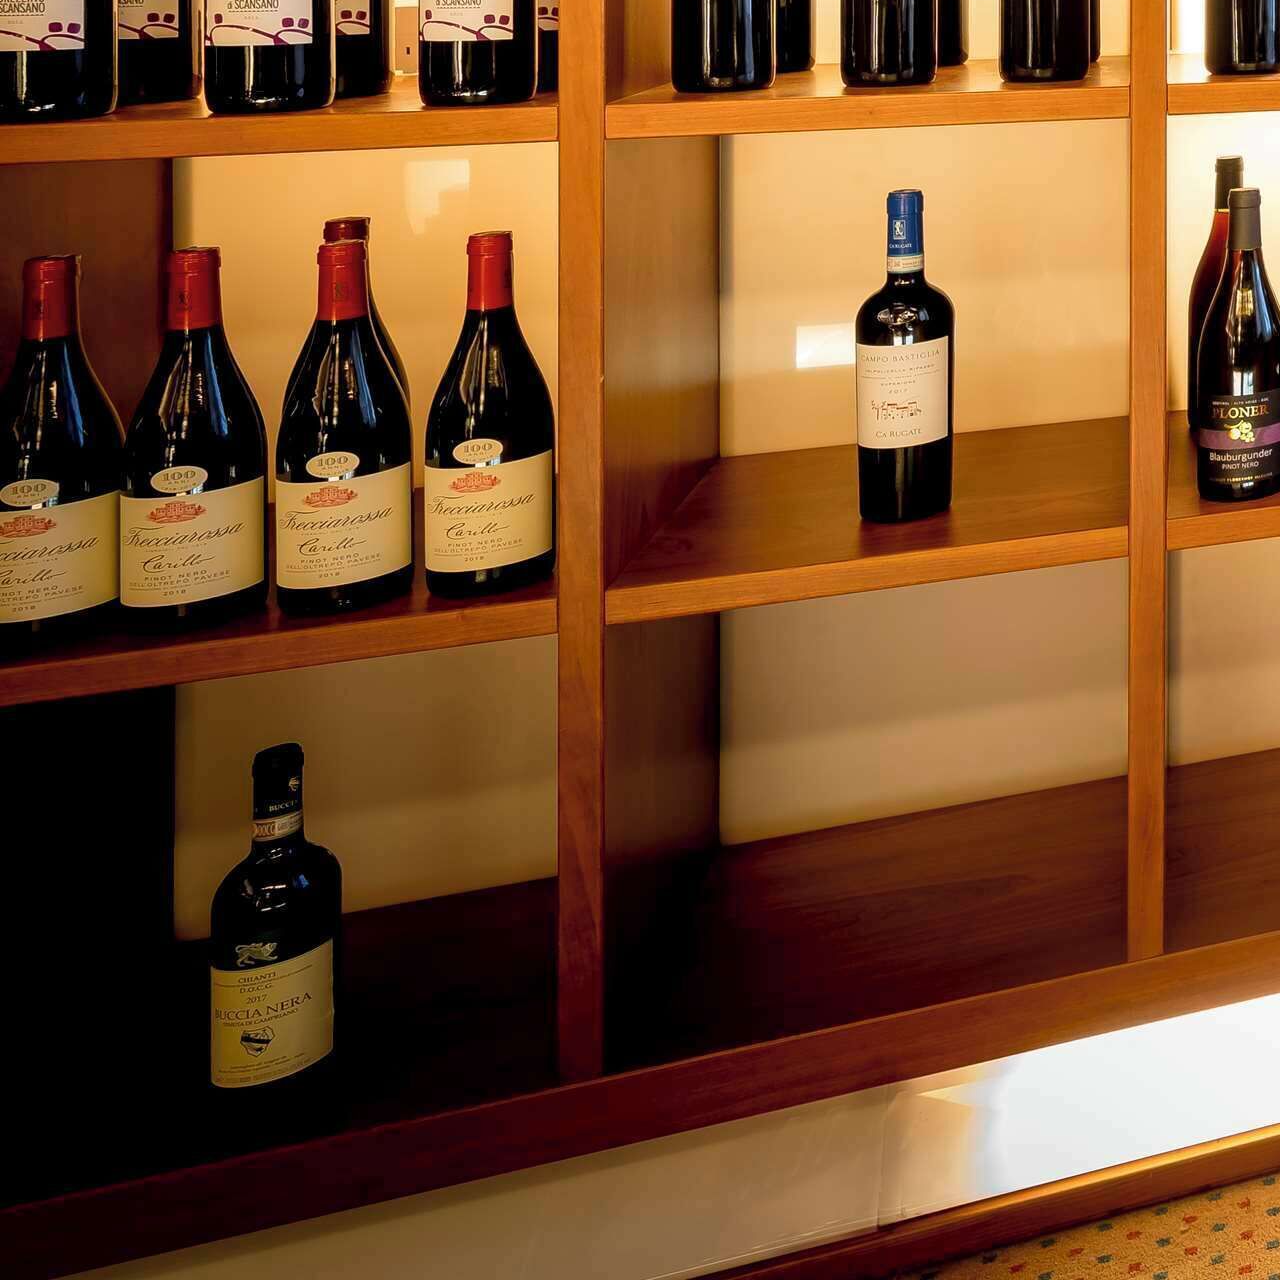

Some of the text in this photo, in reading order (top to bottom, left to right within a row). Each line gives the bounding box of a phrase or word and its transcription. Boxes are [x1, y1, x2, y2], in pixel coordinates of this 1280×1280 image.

[227, 0, 279, 10] di SCANSANO
[861, 349, 939, 362] CAMPO BASTIGLIA
[1212, 404, 1269, 419] PLONER
[889, 428, 921, 437] RUGATE
[463, 443, 493, 453] 100
[318, 455, 349, 467] 100
[1209, 447, 1273, 463] Blauburgunder
[1221, 460, 1260, 470] PINOT NERO
[162, 471, 196, 481] 100
[11, 483, 47, 495] 100
[427, 493, 536, 516] Frecciarossa
[280, 506, 394, 531] Frecciarossa
[122, 520, 247, 548] Frecciarossa
[444, 521, 511, 540] Carillo
[477, 537, 503, 545] NERO
[491, 538, 523, 549] PAVESE
[333, 552, 360, 561] NERO
[347, 553, 381, 564] PAVESE
[140, 553, 216, 574] Carillo
[178, 569, 208, 578] NERO
[195, 569, 230, 581] PAVESE
[28, 585, 58, 594] NERO
[44, 585, 84, 597] PAVESE
[238, 972, 276, 984] CHIANTI
[246, 994, 267, 1005] 2017
[215, 992, 312, 1021] BUCCIA NERA
